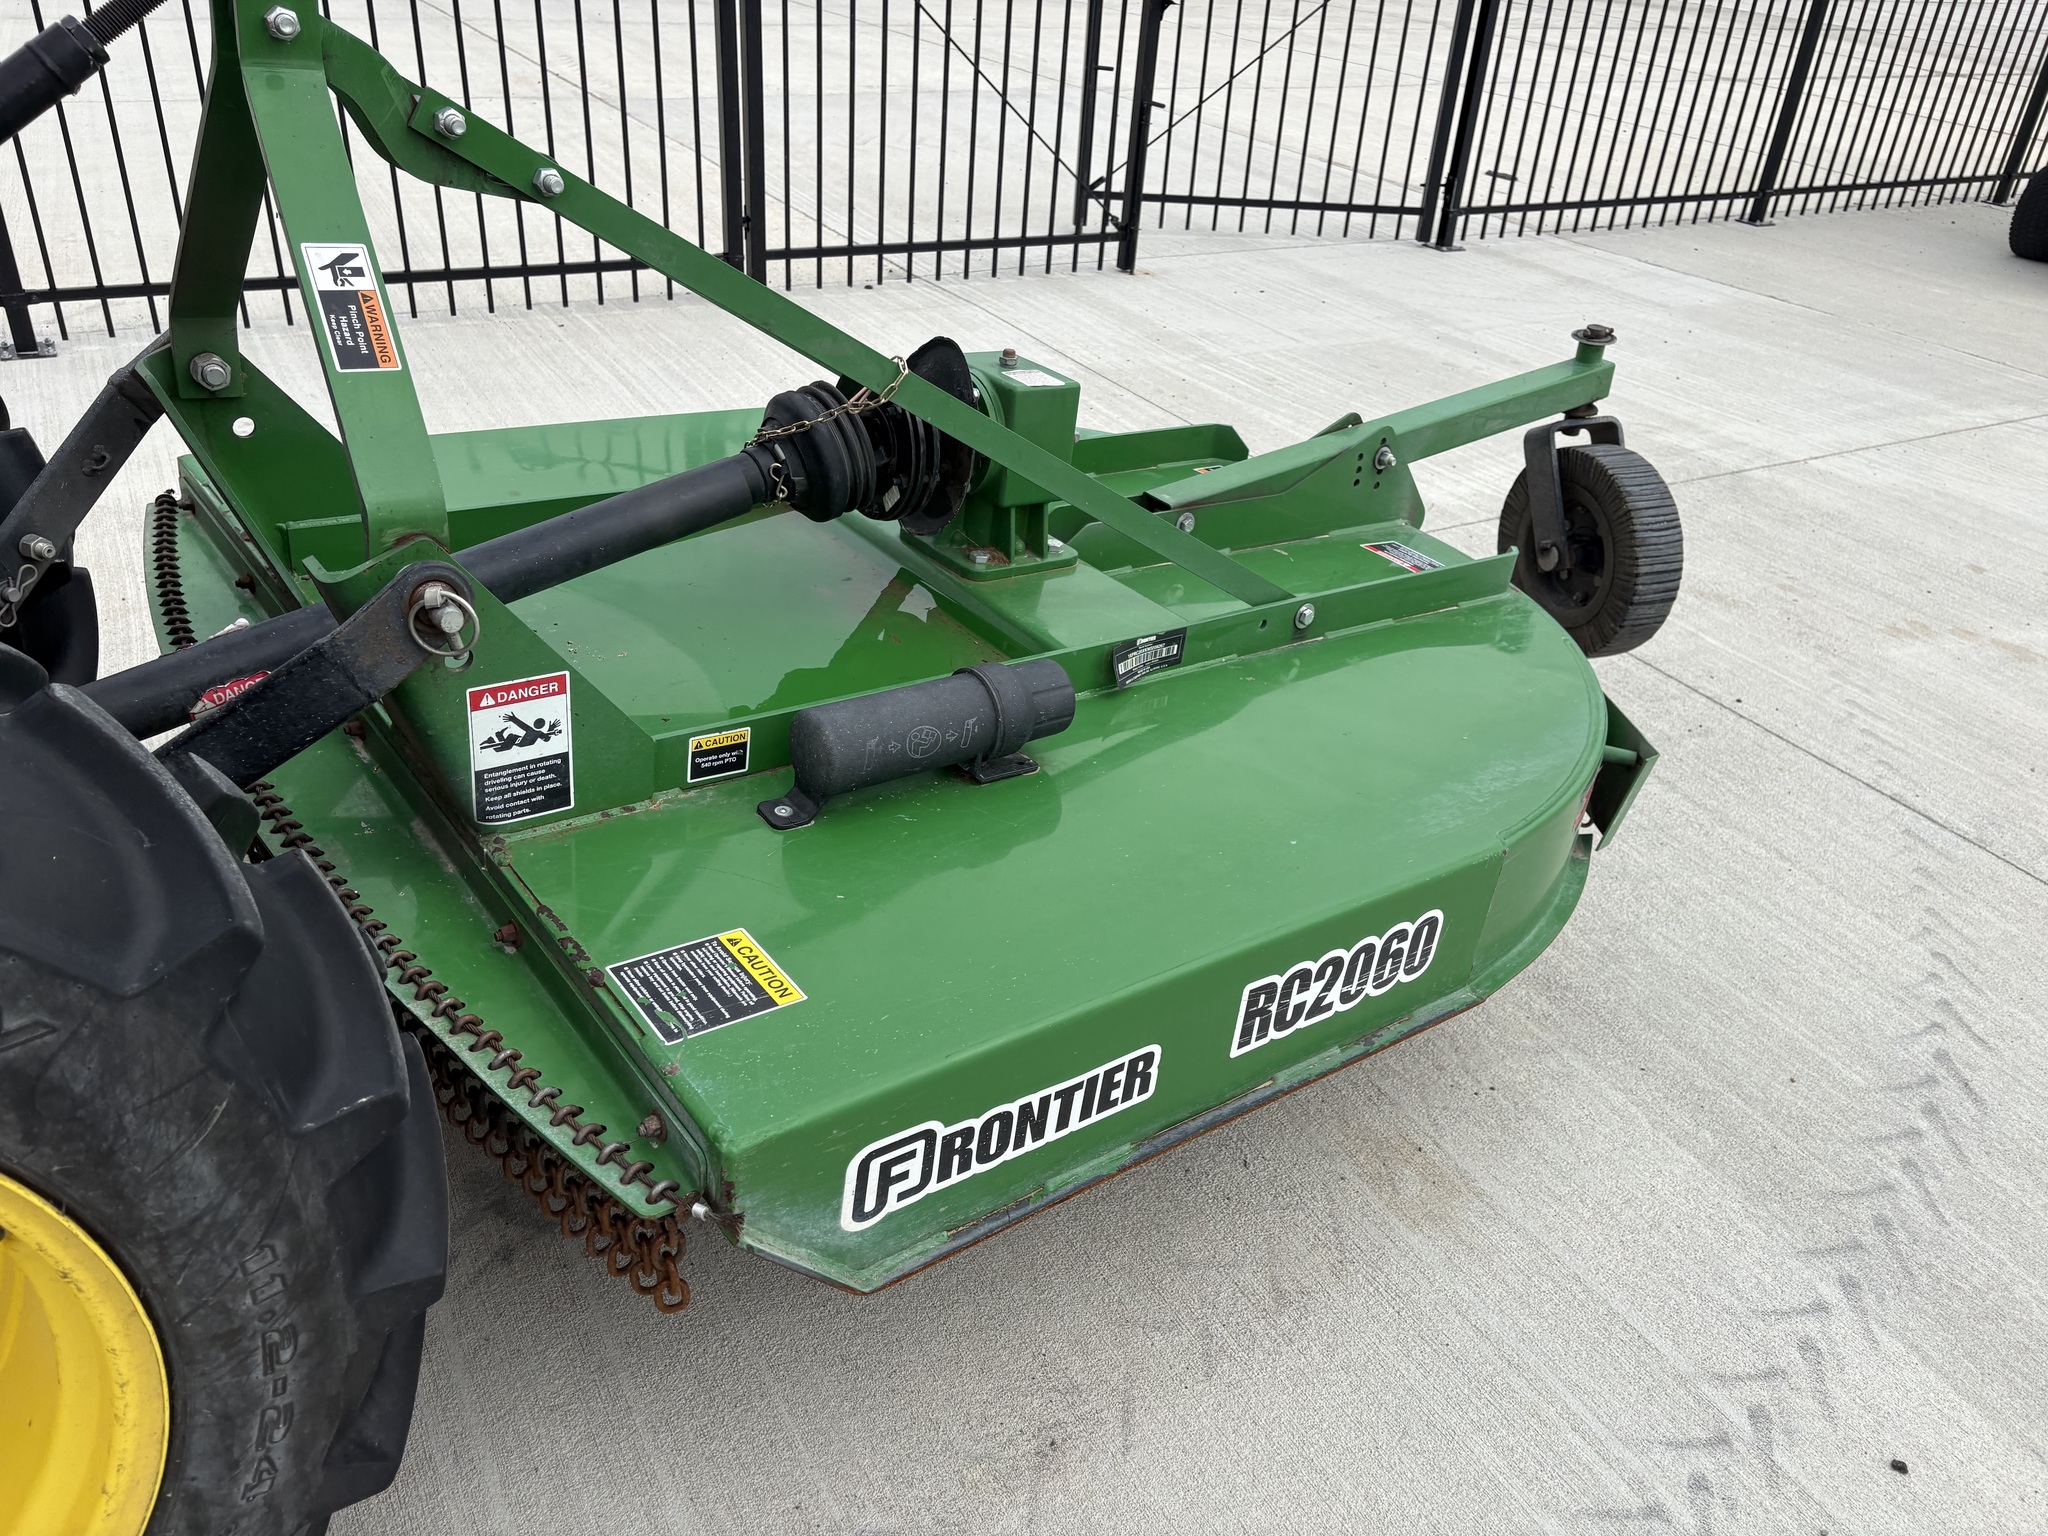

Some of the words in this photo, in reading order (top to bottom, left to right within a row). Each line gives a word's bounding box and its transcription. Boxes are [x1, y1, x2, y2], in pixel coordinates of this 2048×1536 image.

[334, 330, 342, 346] Clear
[339, 316, 354, 346] Hazard
[348, 305, 361, 329] Pinch
[356, 331, 369, 354] Point
[366, 304, 391, 363] WARNING
[213, 677, 263, 705] DAN
[498, 682, 558, 702] DANGER
[705, 733, 745, 747] CAUTION
[484, 766, 528, 779] Entanglement
[537, 758, 561, 768] rotating
[695, 755, 717, 763] Operate
[485, 784, 508, 793] serious
[510, 780, 527, 788] injury
[513, 788, 535, 796] shields
[544, 782, 562, 790] place.
[486, 811, 511, 819] rotating
[513, 808, 531, 816] parts.
[506, 799, 530, 808] contact
[737, 946, 793, 999] CAUTION
[1236, 916, 1439, 1050] RC2060
[852, 1051, 1156, 1223] FRONTIER
[240, 1245, 298, 1502] 11.2-24
